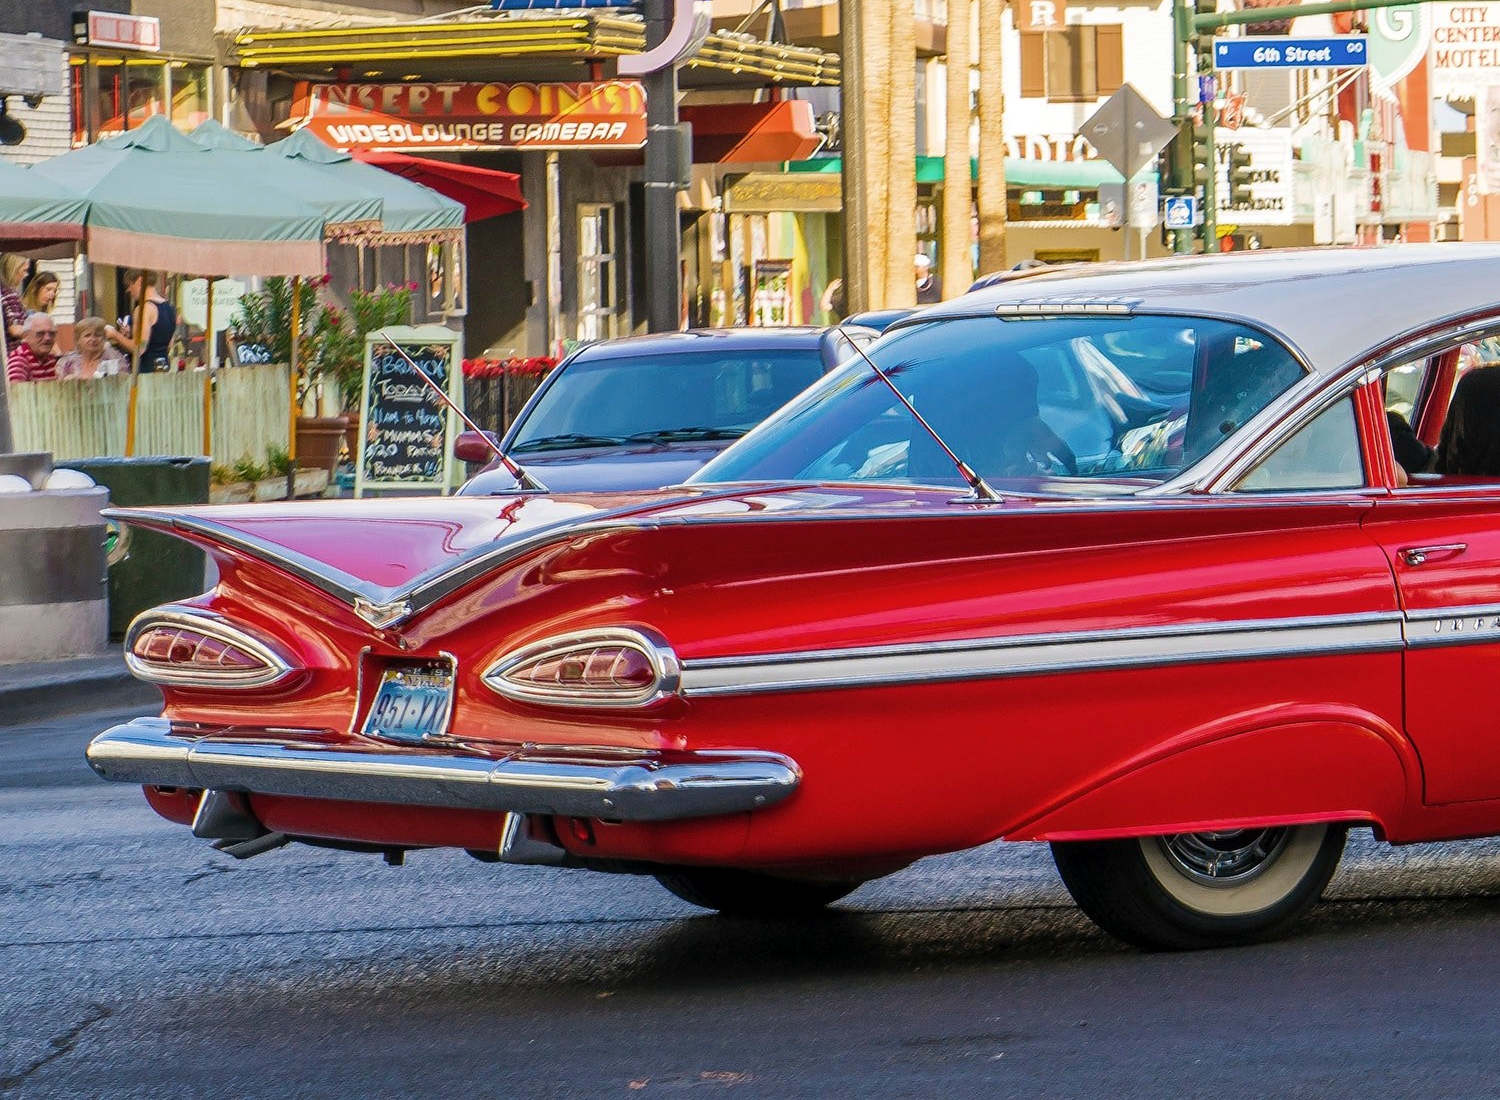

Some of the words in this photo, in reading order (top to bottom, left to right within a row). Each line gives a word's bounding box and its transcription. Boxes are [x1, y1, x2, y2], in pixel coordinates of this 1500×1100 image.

[1450, 6, 1488, 24] CITY
[1253, 46, 1281, 63] 6th
[1285, 46, 1332, 62] Street
[326, 122, 504, 144] VIDEOLOUNGE
[510, 121, 629, 143] GAMEBAR
